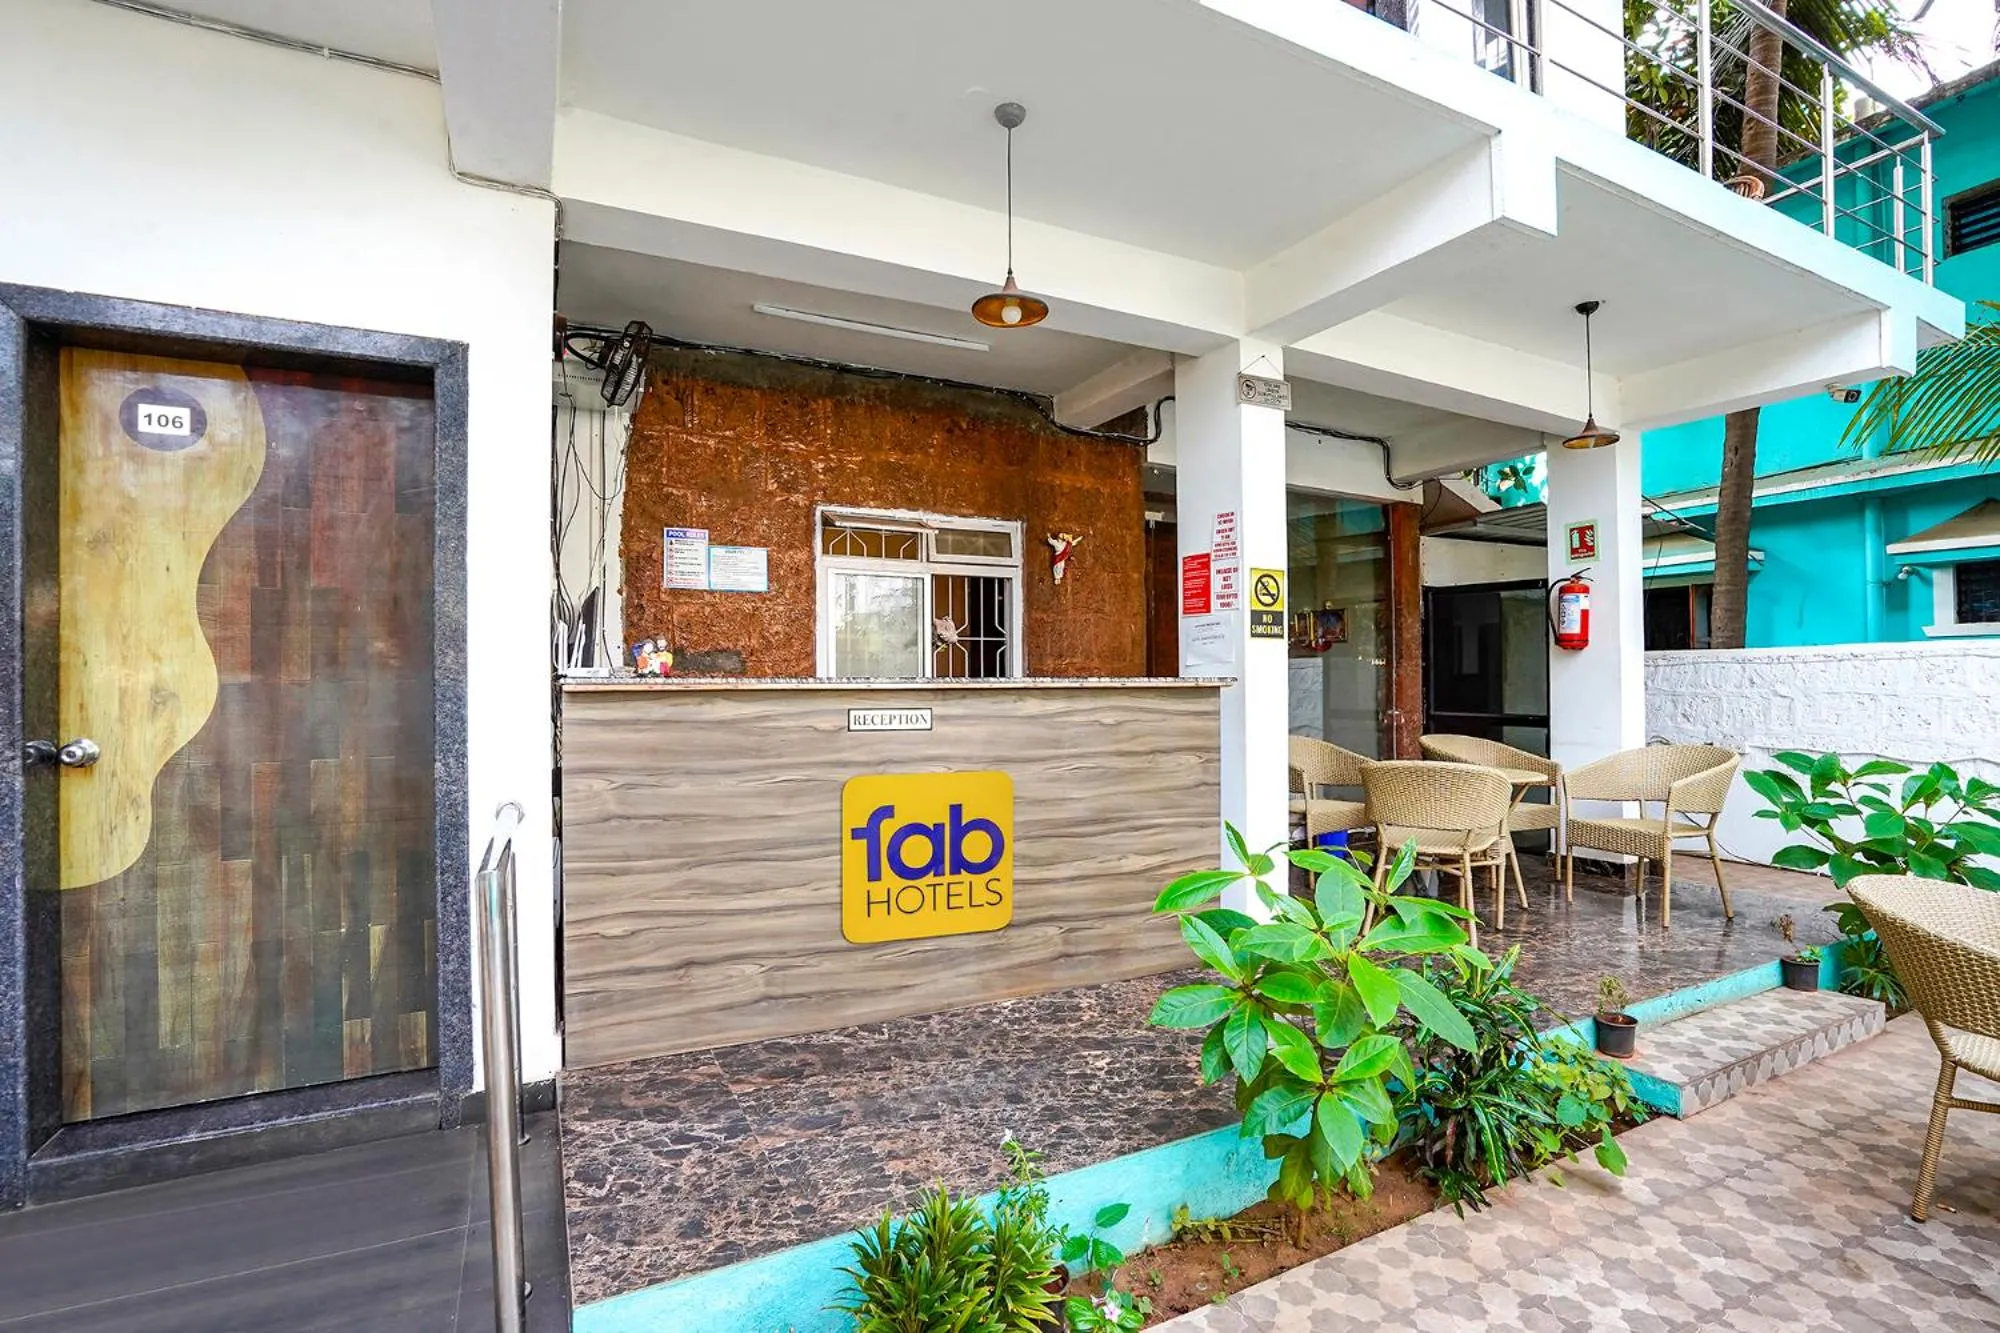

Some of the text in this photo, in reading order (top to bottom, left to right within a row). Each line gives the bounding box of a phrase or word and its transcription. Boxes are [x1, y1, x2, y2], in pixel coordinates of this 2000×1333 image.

[143, 413, 184, 429] 106
[669, 530, 685, 538] POOL
[1262, 614, 1273, 623] NO
[1251, 624, 1283, 635] SMOKING
[853, 713, 929, 726] RECEPTION
[851, 804, 1005, 882] fab
[867, 878, 1003, 917] HOTELS
